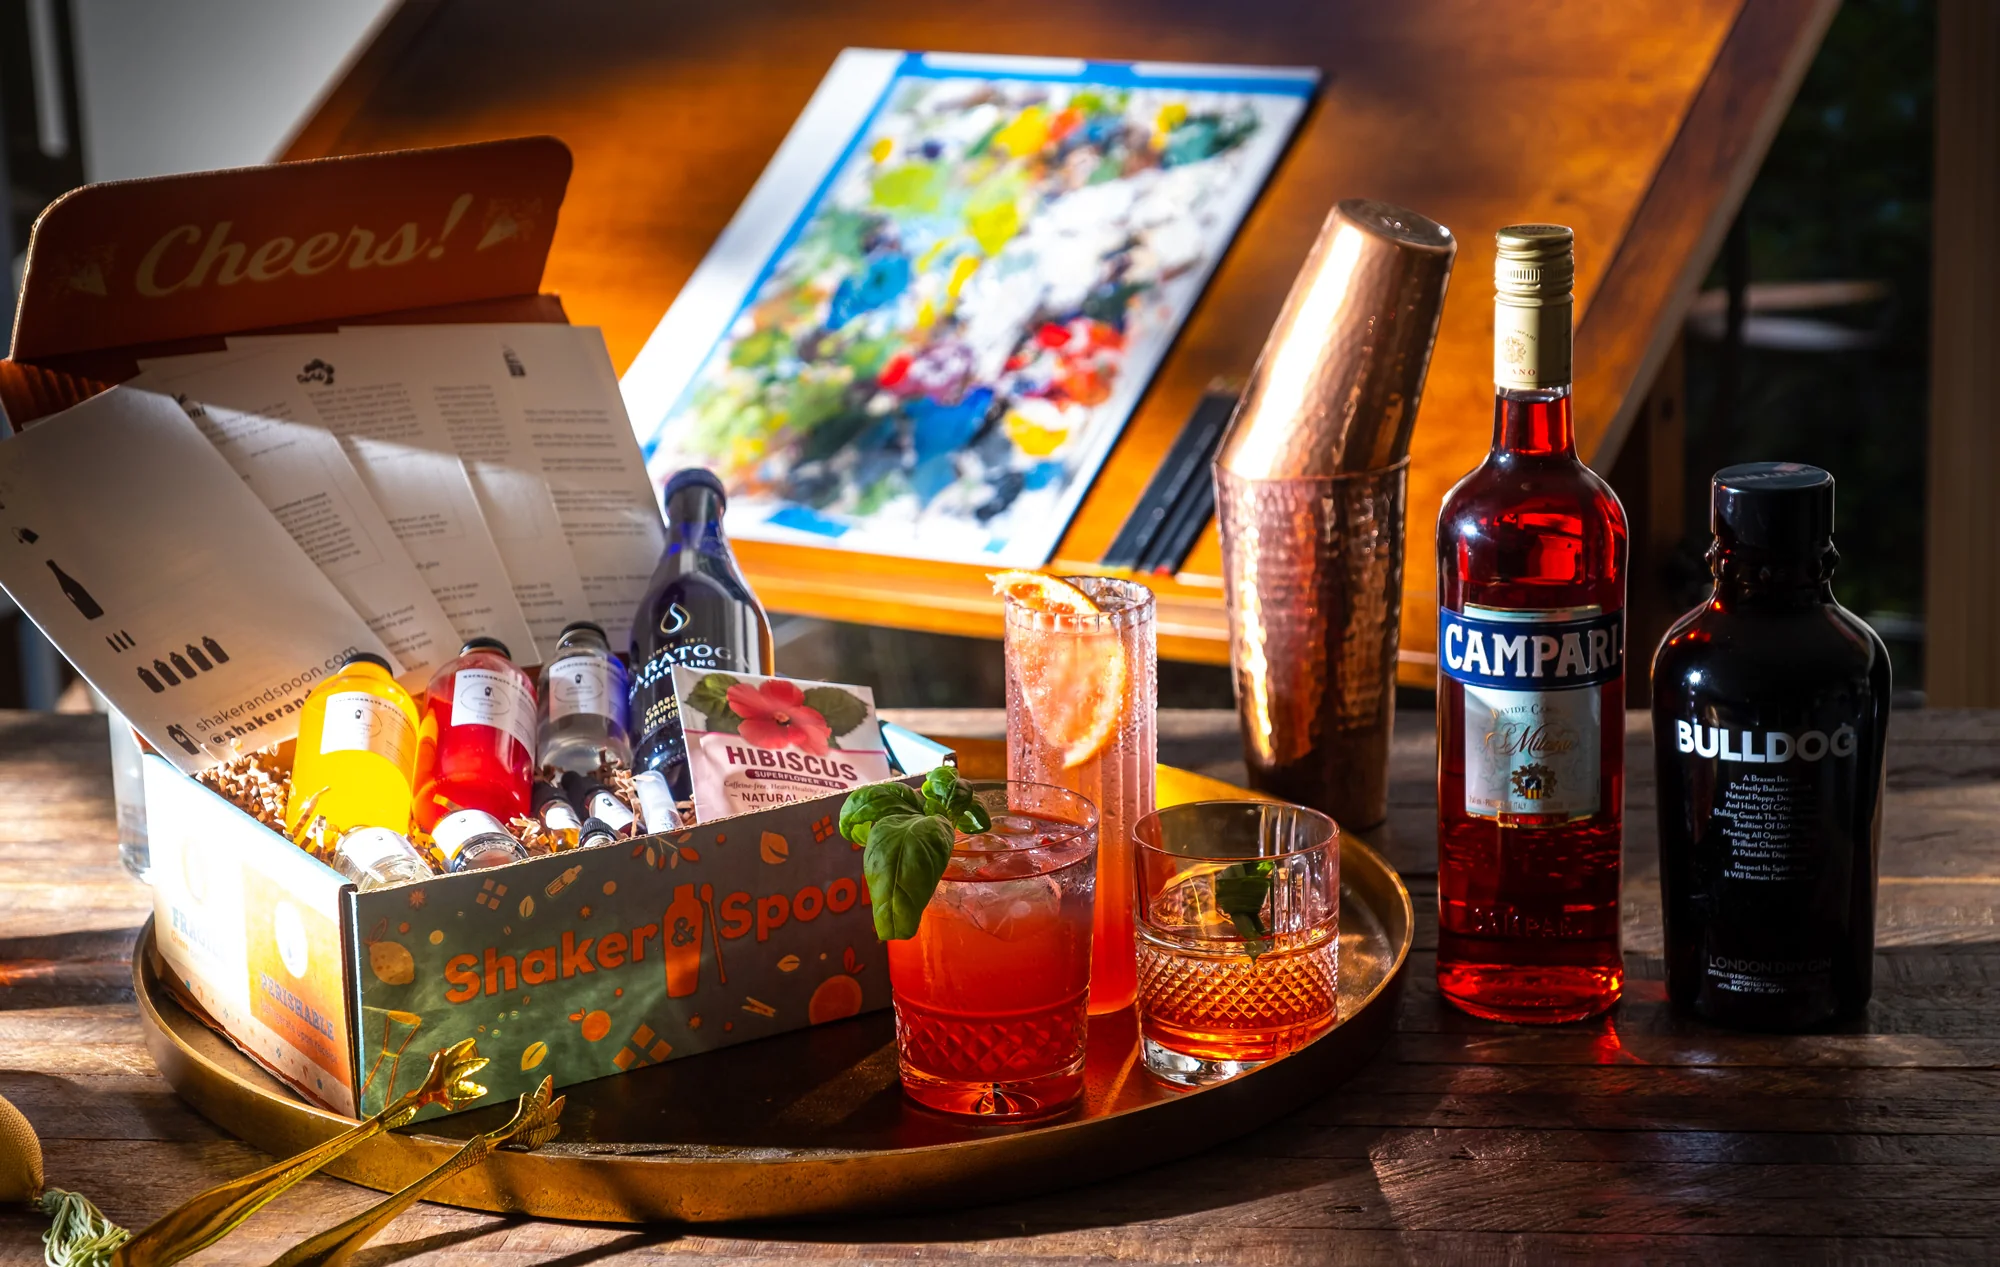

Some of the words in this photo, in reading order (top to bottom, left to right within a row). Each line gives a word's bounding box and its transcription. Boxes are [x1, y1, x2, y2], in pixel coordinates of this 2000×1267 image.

[136, 193, 475, 297] Cheers!
[1445, 622, 1618, 677] CAMPARI
[644, 659, 717, 690] SPARLING
[196, 645, 359, 733] shakerandspoon.com
[1676, 719, 1858, 763] BULLDOG
[725, 745, 858, 781] HIBISCUS
[1743, 774, 1750, 782] A
[1751, 775, 1776, 783] Brazen
[824, 780, 841, 789] TEA
[1730, 782, 1762, 793] Perfectly
[1763, 785, 1793, 793] Balance
[1725, 791, 1751, 801] Natural
[1725, 801, 1740, 810] And
[1741, 802, 1760, 811] Hints
[1761, 803, 1772, 811] Of
[1714, 808, 1738, 819] Bulldog
[1733, 820, 1763, 829] Tradition
[1764, 822, 1775, 830] Of
[1722, 828, 1750, 839] Meeting
[1751, 831, 1762, 839] All
[1732, 839, 1758, 848] Brilliant
[1759, 841, 1792, 849] Characte
[1740, 849, 1770, 858] Palatable
[1734, 861, 1761, 871] Respect
[1730, 871, 1744, 880] Will
[443, 921, 660, 1004] Shaker
[670, 915, 697, 947] &
[718, 876, 873, 942] Spoo
[1709, 954, 1772, 973] LONDON
[259, 971, 336, 1042] PERISHABLE
